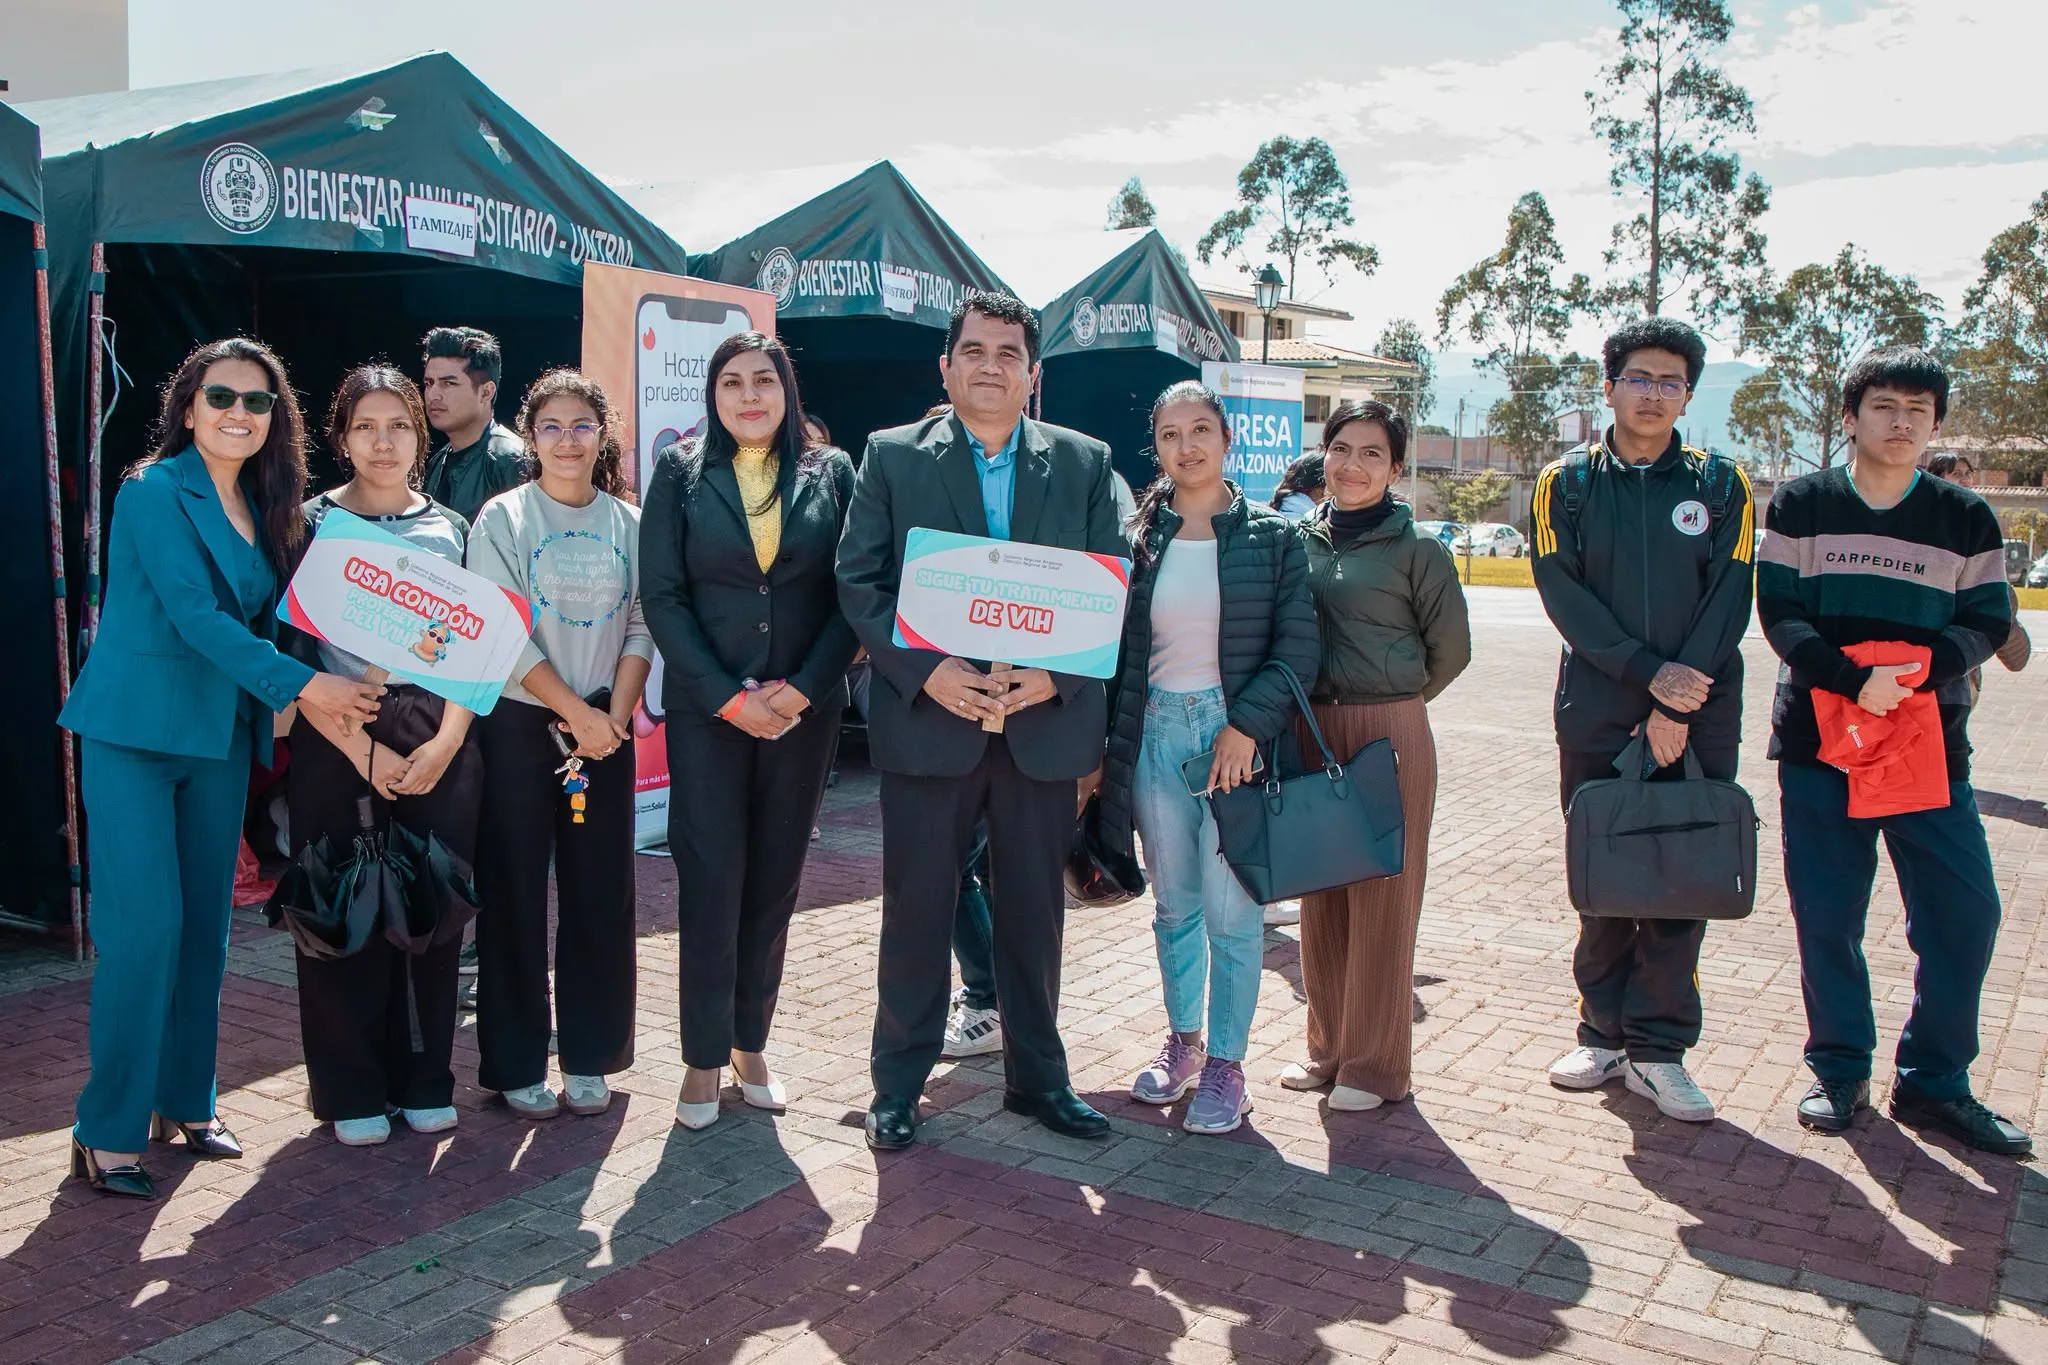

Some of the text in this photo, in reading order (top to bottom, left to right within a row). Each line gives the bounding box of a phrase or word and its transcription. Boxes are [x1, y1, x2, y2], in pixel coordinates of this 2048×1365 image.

[283, 166, 406, 228] BIENESTAR
[410, 181, 557, 259] RSITARIO
[409, 215, 474, 241] TAMIZAJE
[799, 259, 875, 297] BIENESTAR
[1099, 303, 1151, 334] BIENESTAR
[664, 351, 711, 378] Hazt
[1229, 412, 1293, 448] IRESA
[1221, 453, 1293, 475] MAZONAS
[1826, 552, 1926, 575] CARPEDIEM
[345, 558, 483, 639] USA CONDÓN
[915, 568, 1118, 615] SIGUE TU TRATAMIENTO
[341, 603, 375, 631] DEL
[969, 599, 1054, 634] DE VIH
